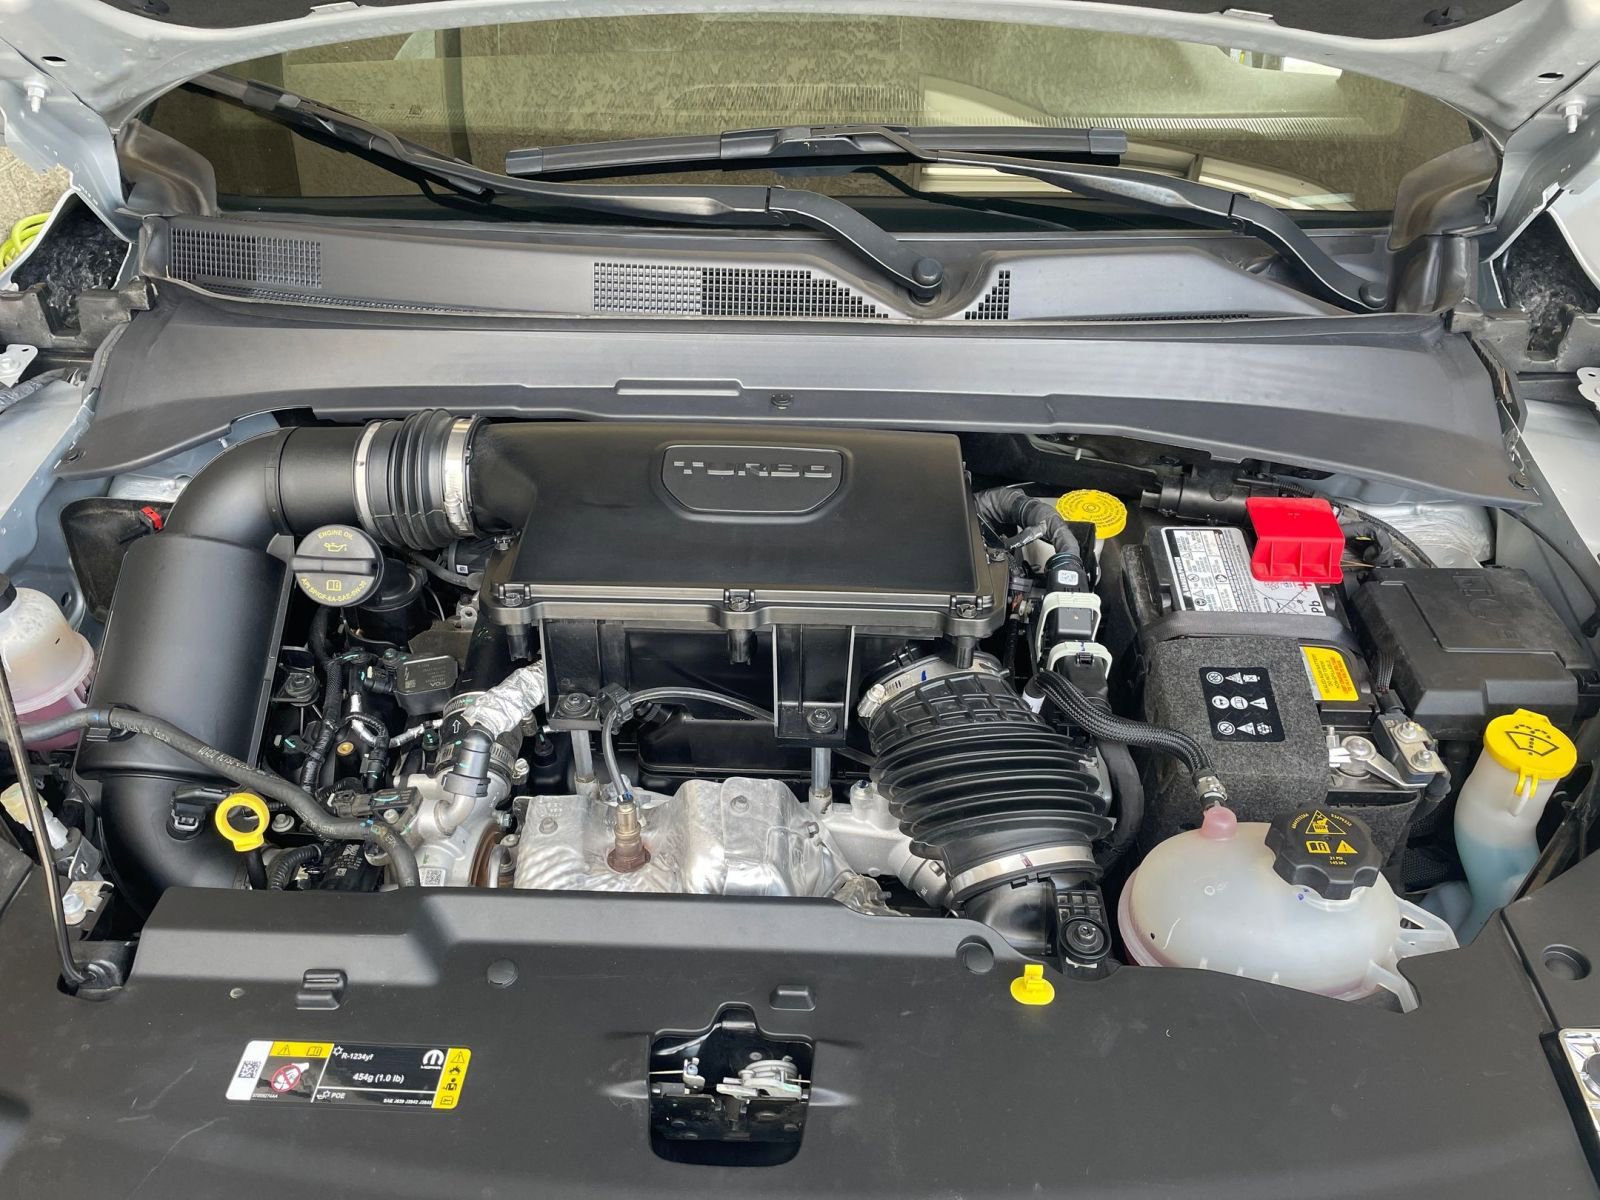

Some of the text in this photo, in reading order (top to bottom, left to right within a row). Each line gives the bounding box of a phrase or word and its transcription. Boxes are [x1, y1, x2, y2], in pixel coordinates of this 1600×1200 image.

[673, 460, 833, 479] TURBO
[318, 529, 353, 540] ENGINE OIL
[1309, 600, 1324, 613] Pb
[341, 1052, 374, 1061] R-1234yf
[352, 1072, 405, 1084] 454g (1.0 lb)
